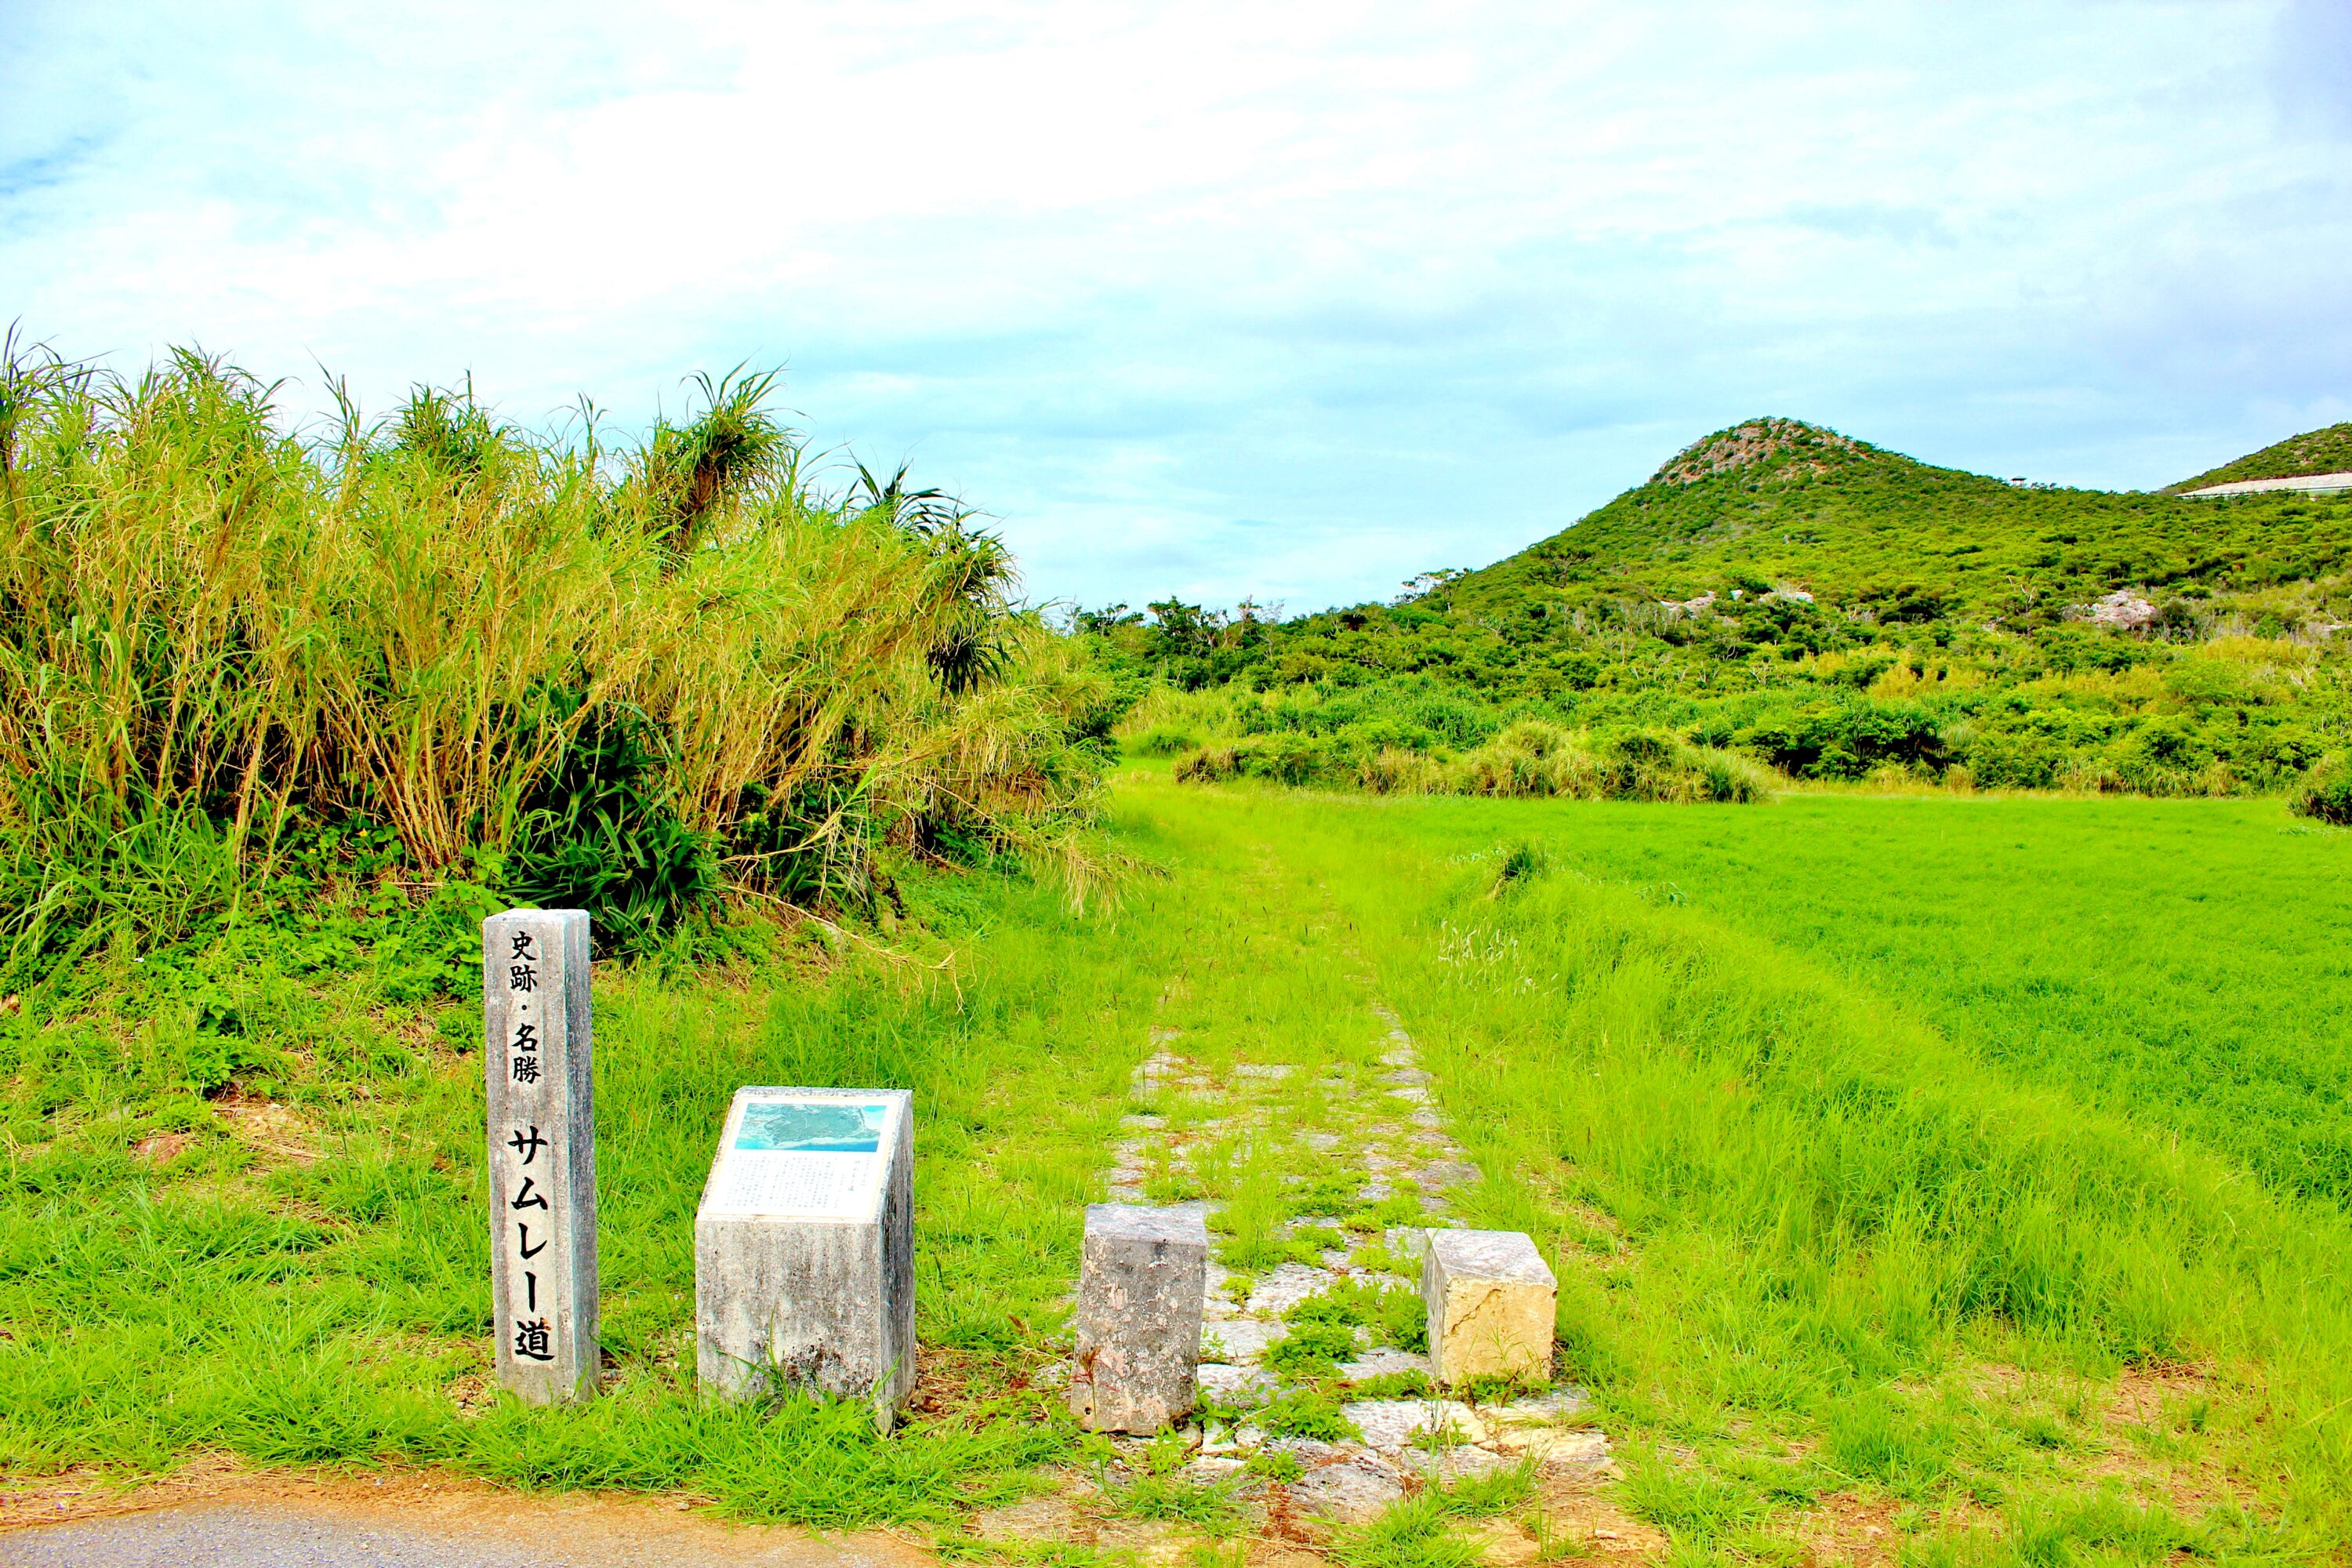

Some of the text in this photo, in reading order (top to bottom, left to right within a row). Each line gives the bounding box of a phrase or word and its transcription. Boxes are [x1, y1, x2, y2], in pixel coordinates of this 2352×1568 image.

[507, 931, 555, 1361] 史跡・名勝 サムレー道
